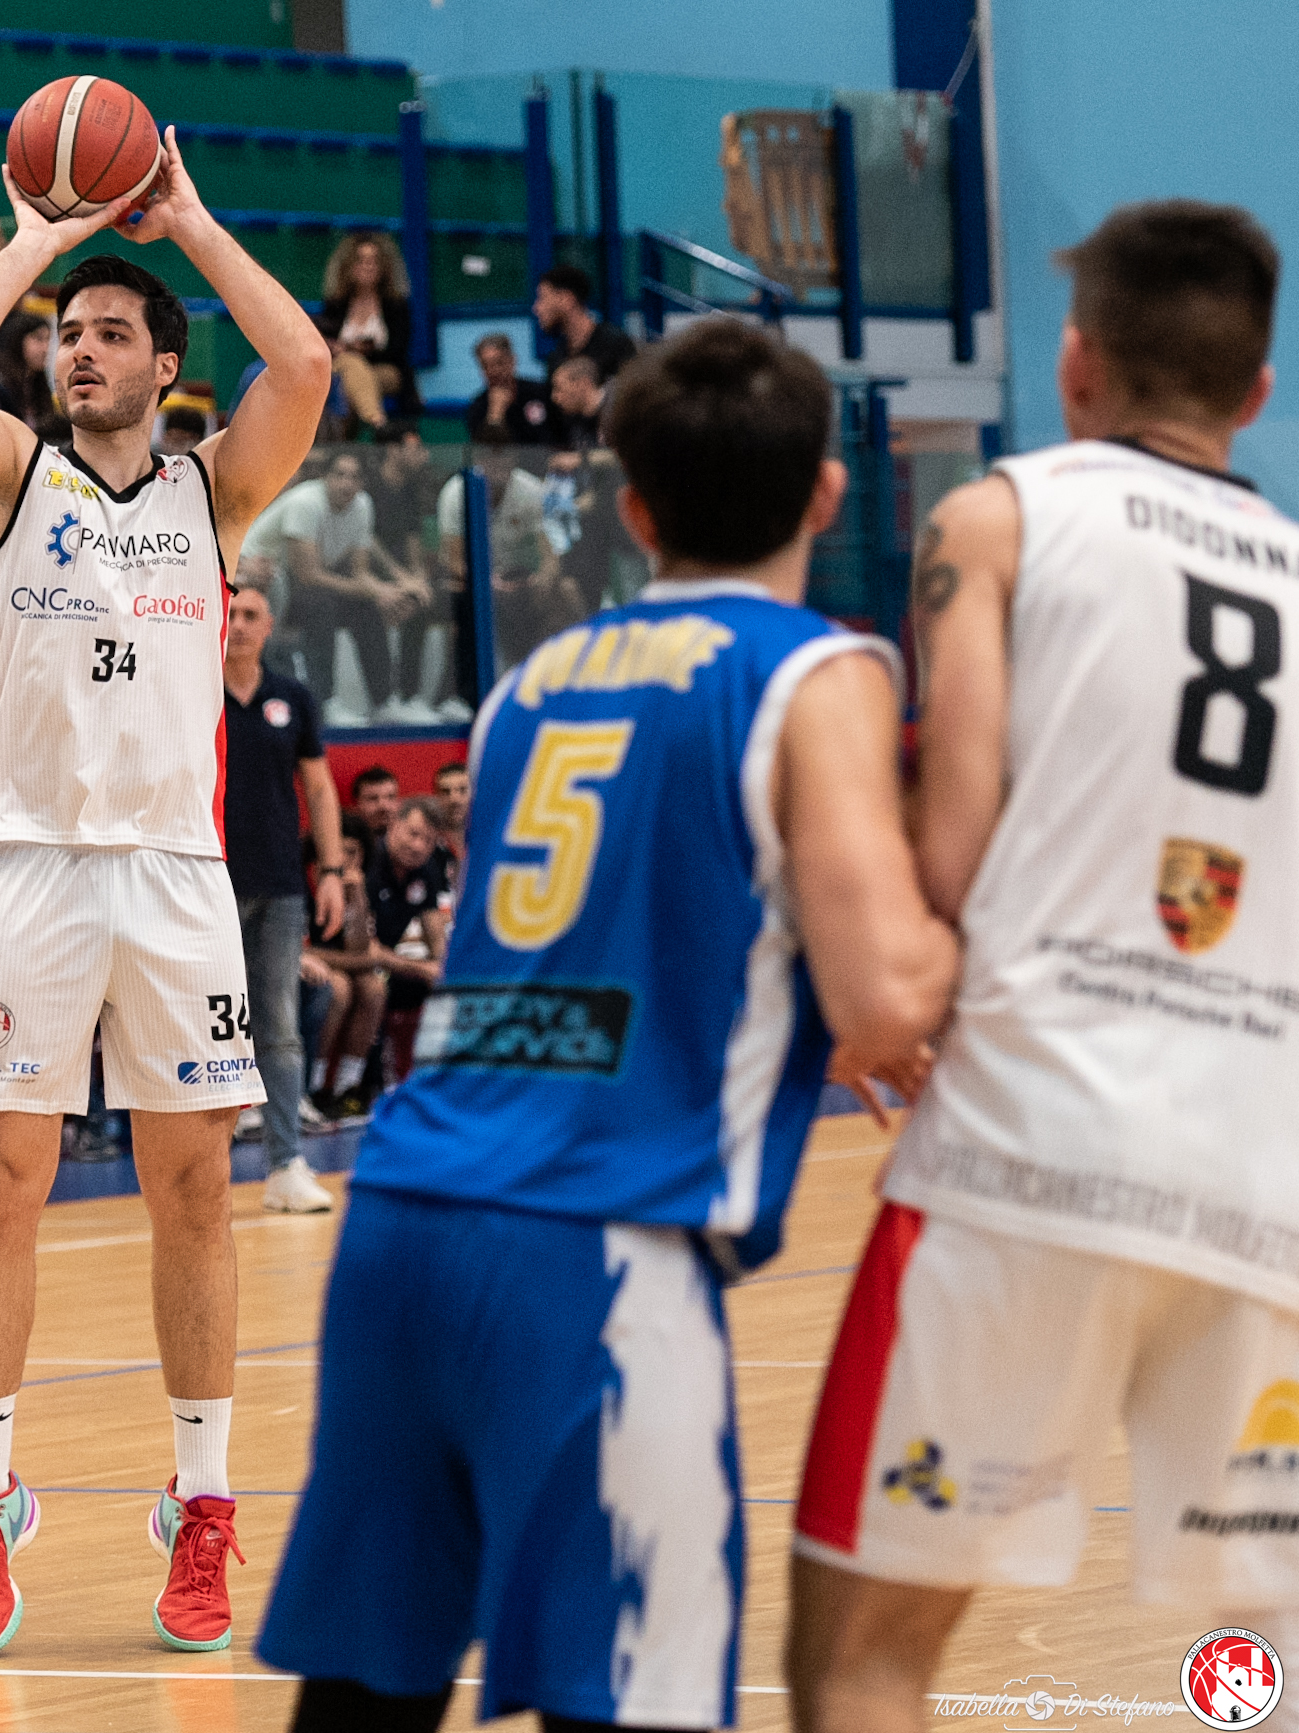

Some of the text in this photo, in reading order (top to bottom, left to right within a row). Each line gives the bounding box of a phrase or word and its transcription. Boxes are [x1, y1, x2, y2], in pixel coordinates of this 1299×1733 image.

[92, 637, 137, 682] 34
[1169, 562, 1282, 799] 8
[486, 718, 636, 951] 5
[206, 993, 251, 1041] 34
[10, 1062, 41, 1075] TEC
